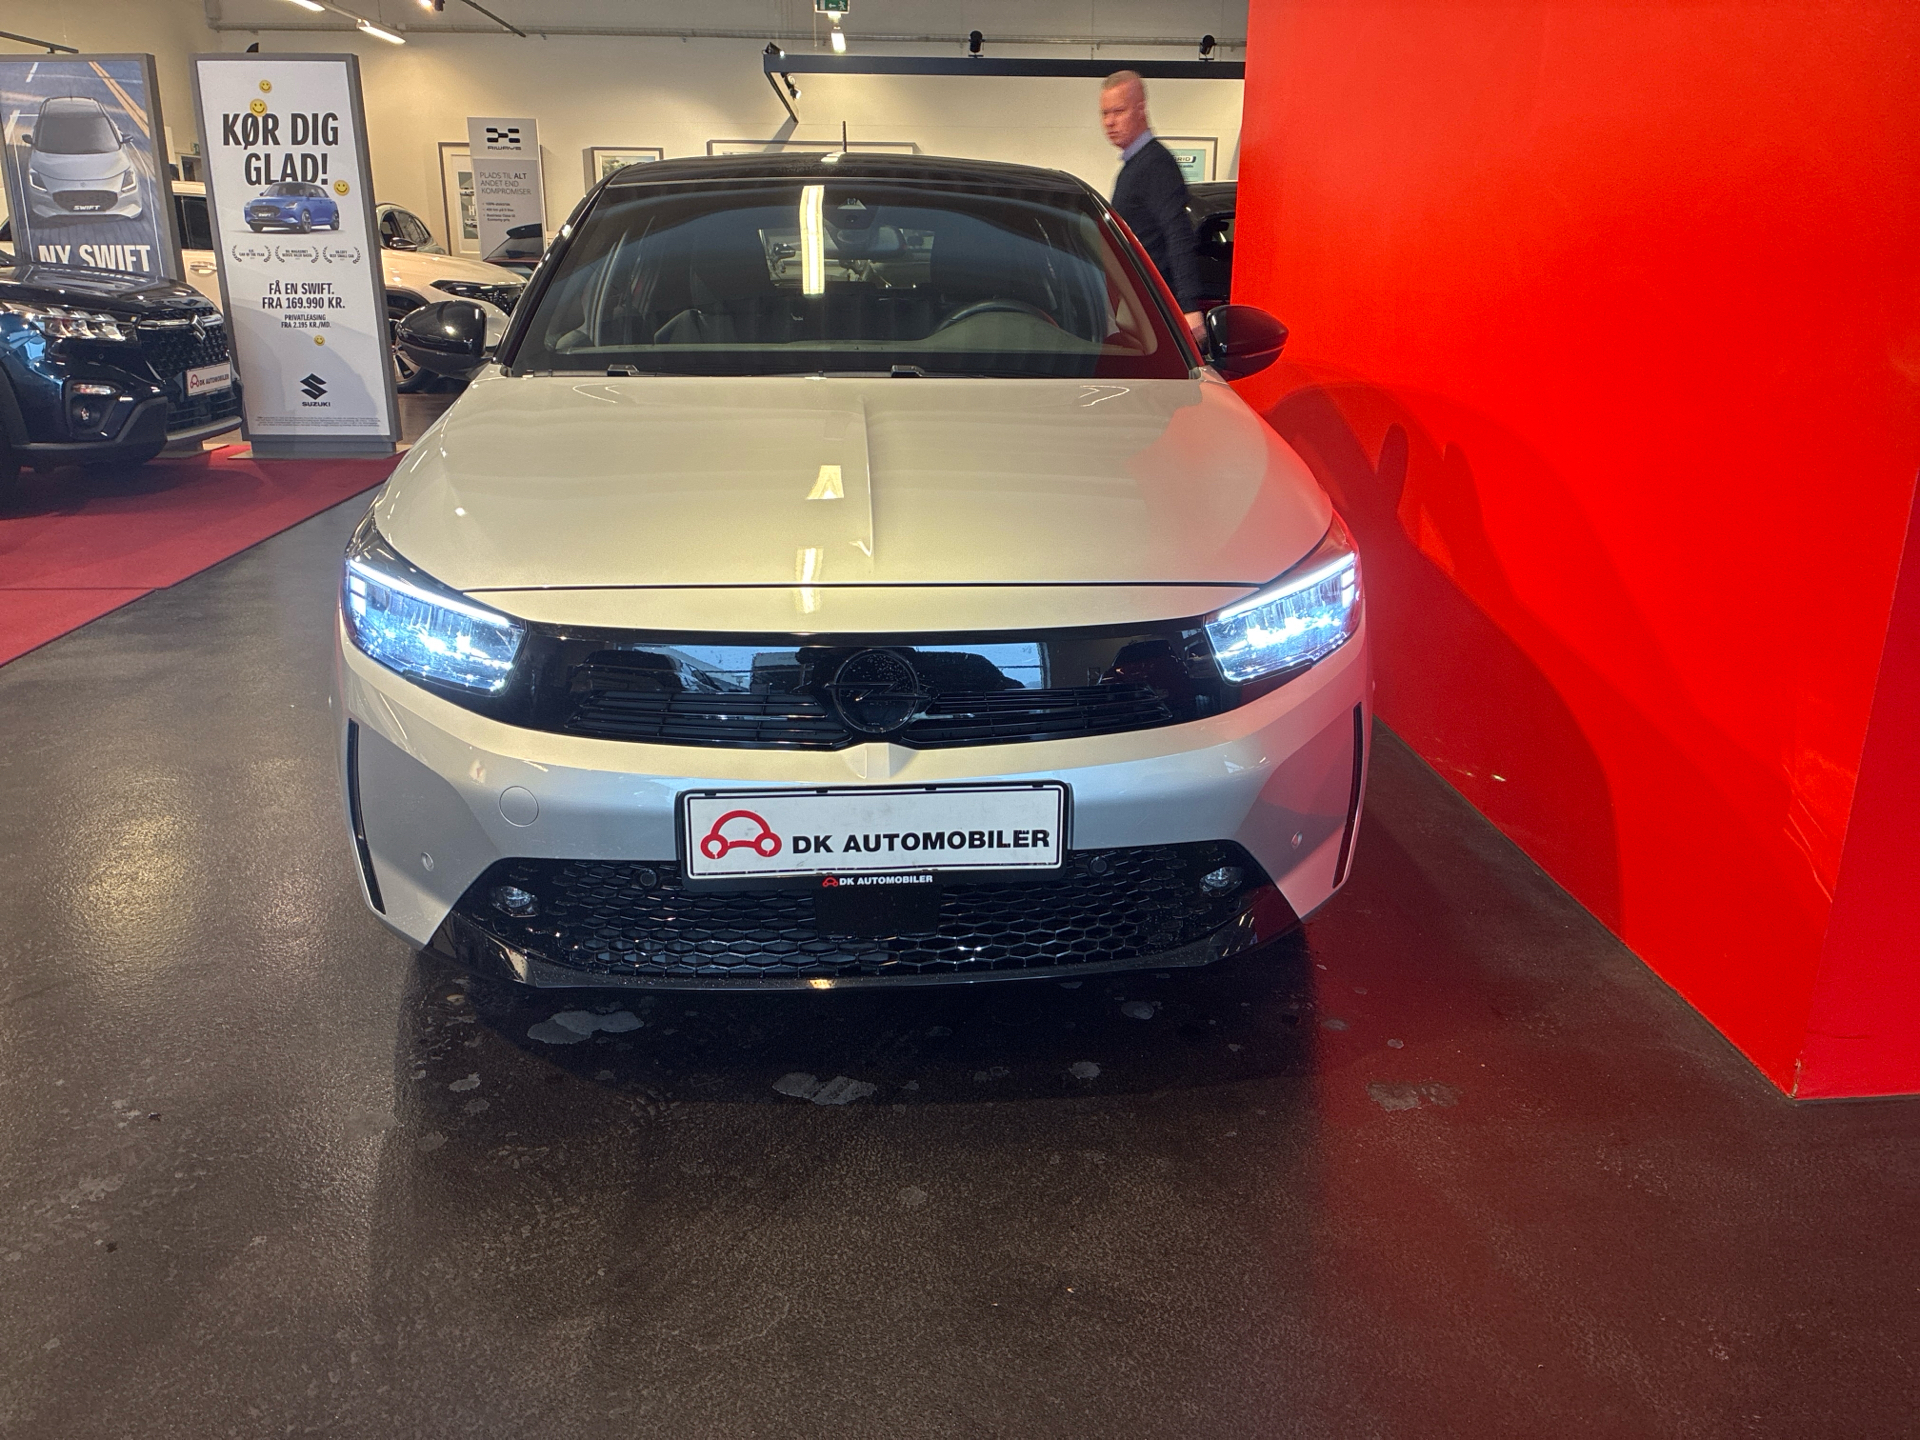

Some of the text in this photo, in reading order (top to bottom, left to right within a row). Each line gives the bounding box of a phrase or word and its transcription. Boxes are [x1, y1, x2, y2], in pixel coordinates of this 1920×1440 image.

[223, 113, 338, 150] KØR DIG
[245, 153, 328, 185] GLAD!
[38, 244, 150, 272] NY SWIFT
[269, 280, 334, 294] FÅ EN SWIFT.
[262, 297, 345, 308] FRA 169.990 KR.
[792, 830, 1050, 854] DK AUTOMOBILER
[857, 875, 933, 885] AUTOMOBILER
